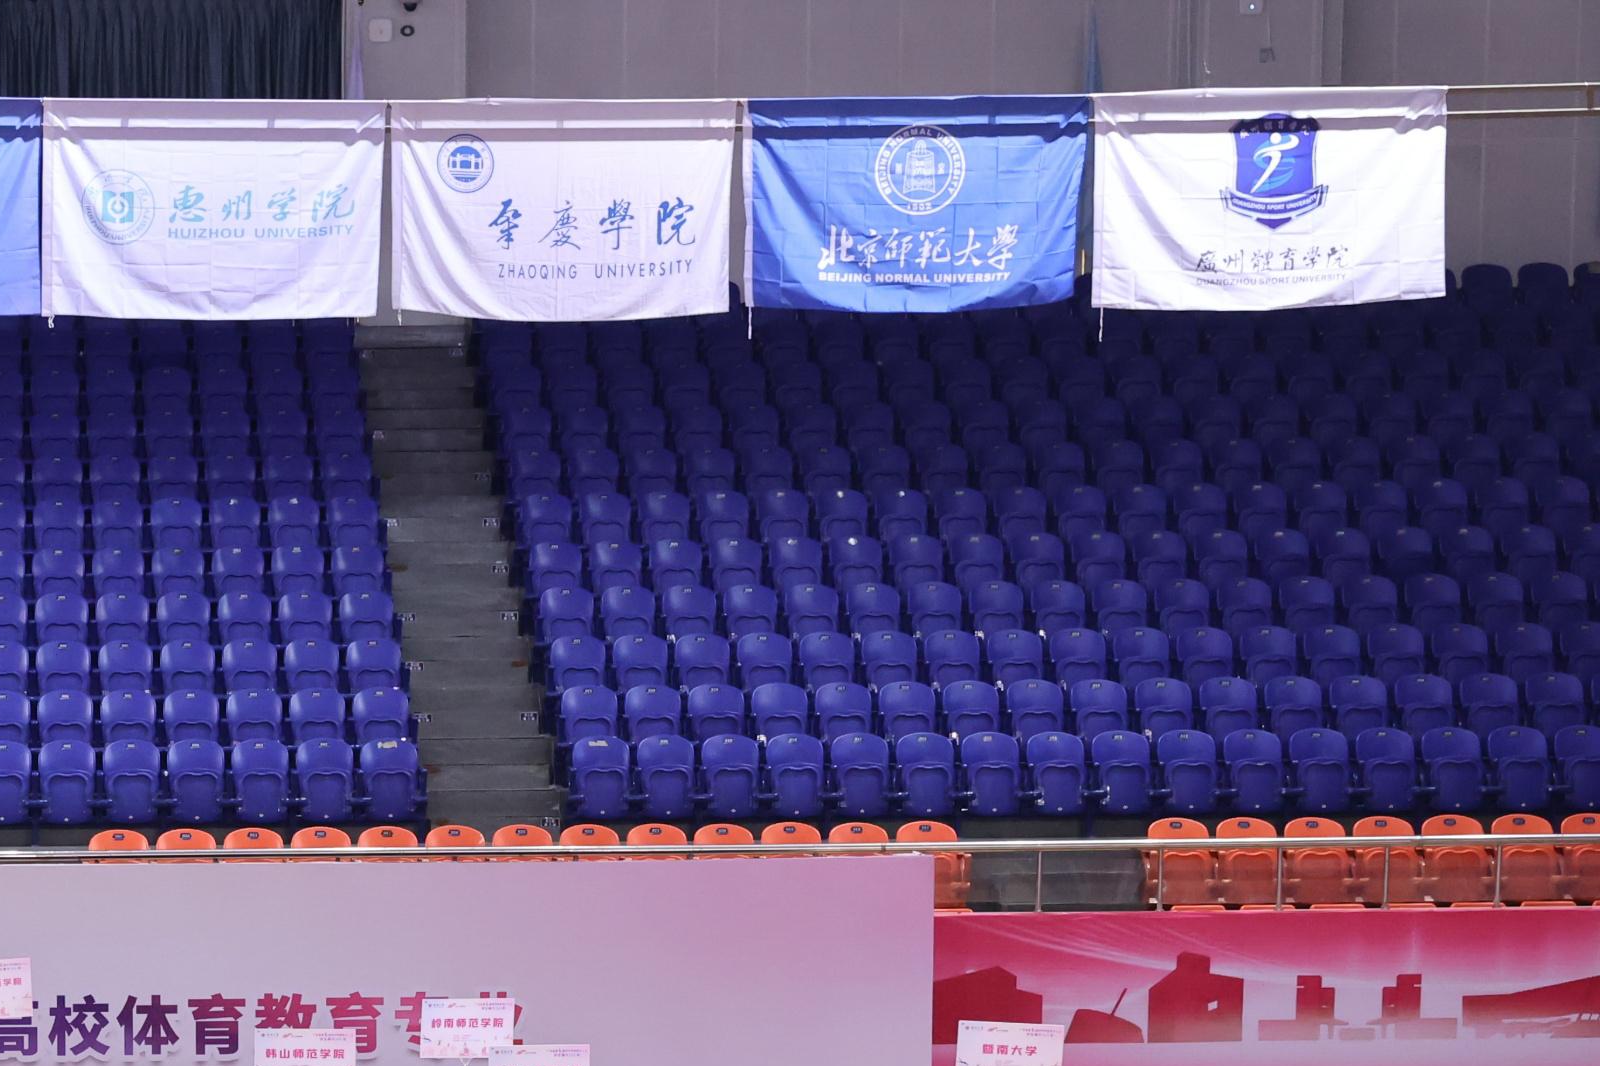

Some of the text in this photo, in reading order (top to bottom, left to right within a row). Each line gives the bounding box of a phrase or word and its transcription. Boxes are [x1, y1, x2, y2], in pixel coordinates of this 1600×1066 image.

[169, 184, 355, 223] 惠州学院
[167, 224, 355, 239] HUIZHOU UNIVERSITY
[498, 258, 693, 279] ZHAOQING UNIVERSITY
[818, 271, 1010, 283] BEIJING NORMAL UNIVERSITY
[431, 1017, 504, 1029] 岭南师范学院
[265, 1048, 346, 1059] 韩山师范学院
[981, 1043, 1038, 1057] 暨南大学
